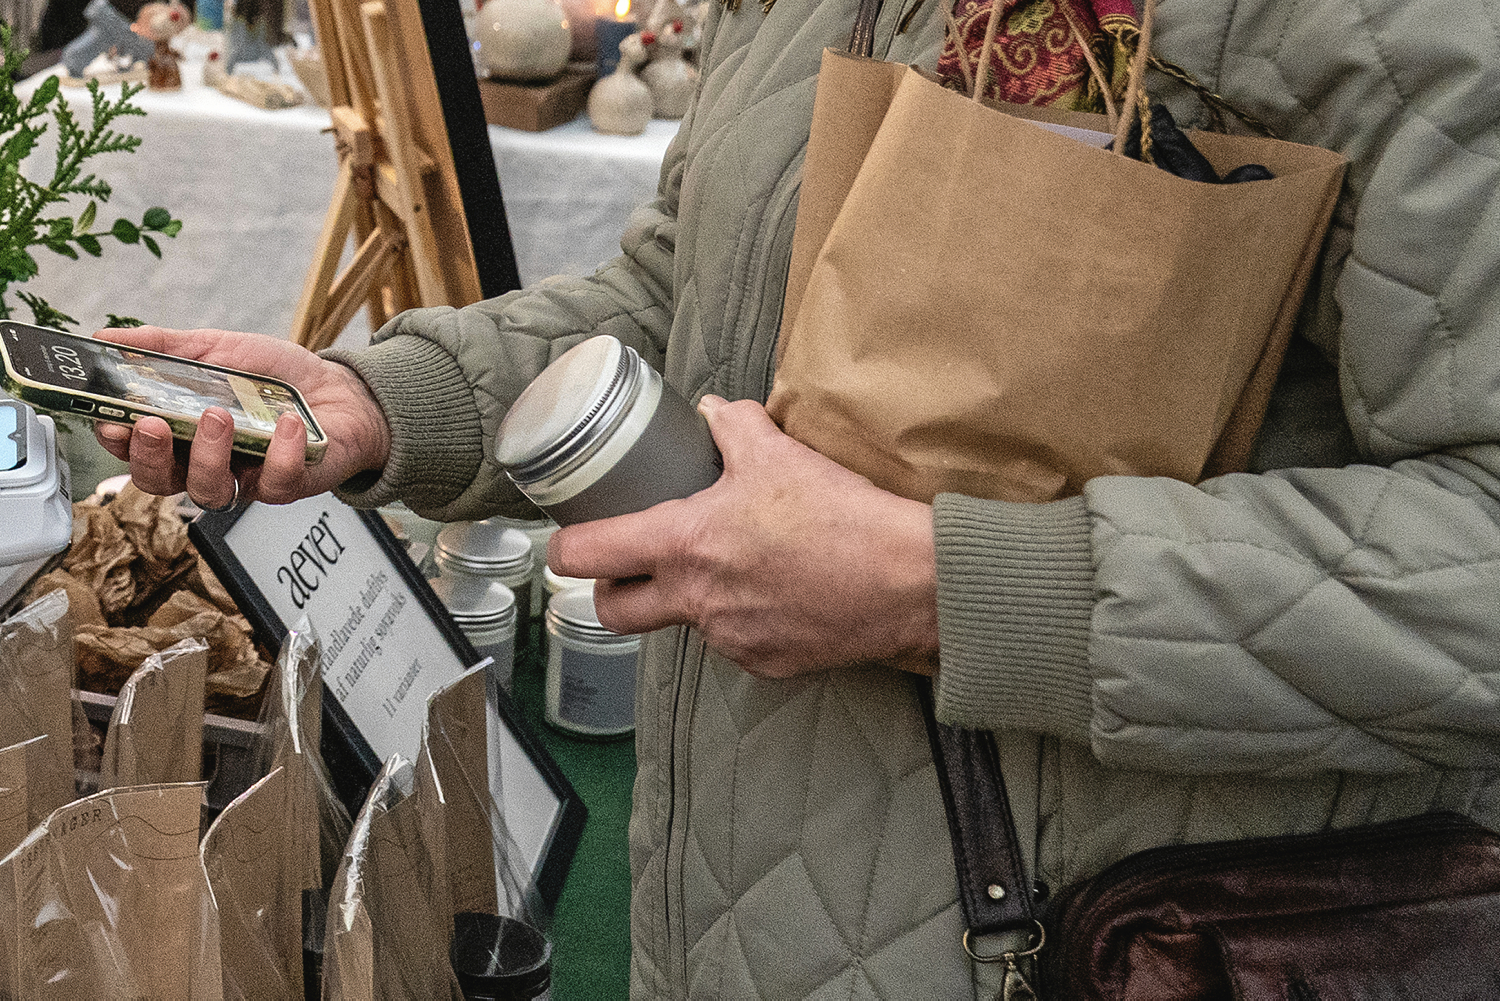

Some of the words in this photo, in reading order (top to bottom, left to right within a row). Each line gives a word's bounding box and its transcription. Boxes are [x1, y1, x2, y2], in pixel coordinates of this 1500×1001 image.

[51, 345, 88, 382] 13.20
[276, 511, 346, 610] aever
[335, 676, 350, 703] af
[345, 635, 384, 699] naturlig
[393, 657, 424, 706] varianter
